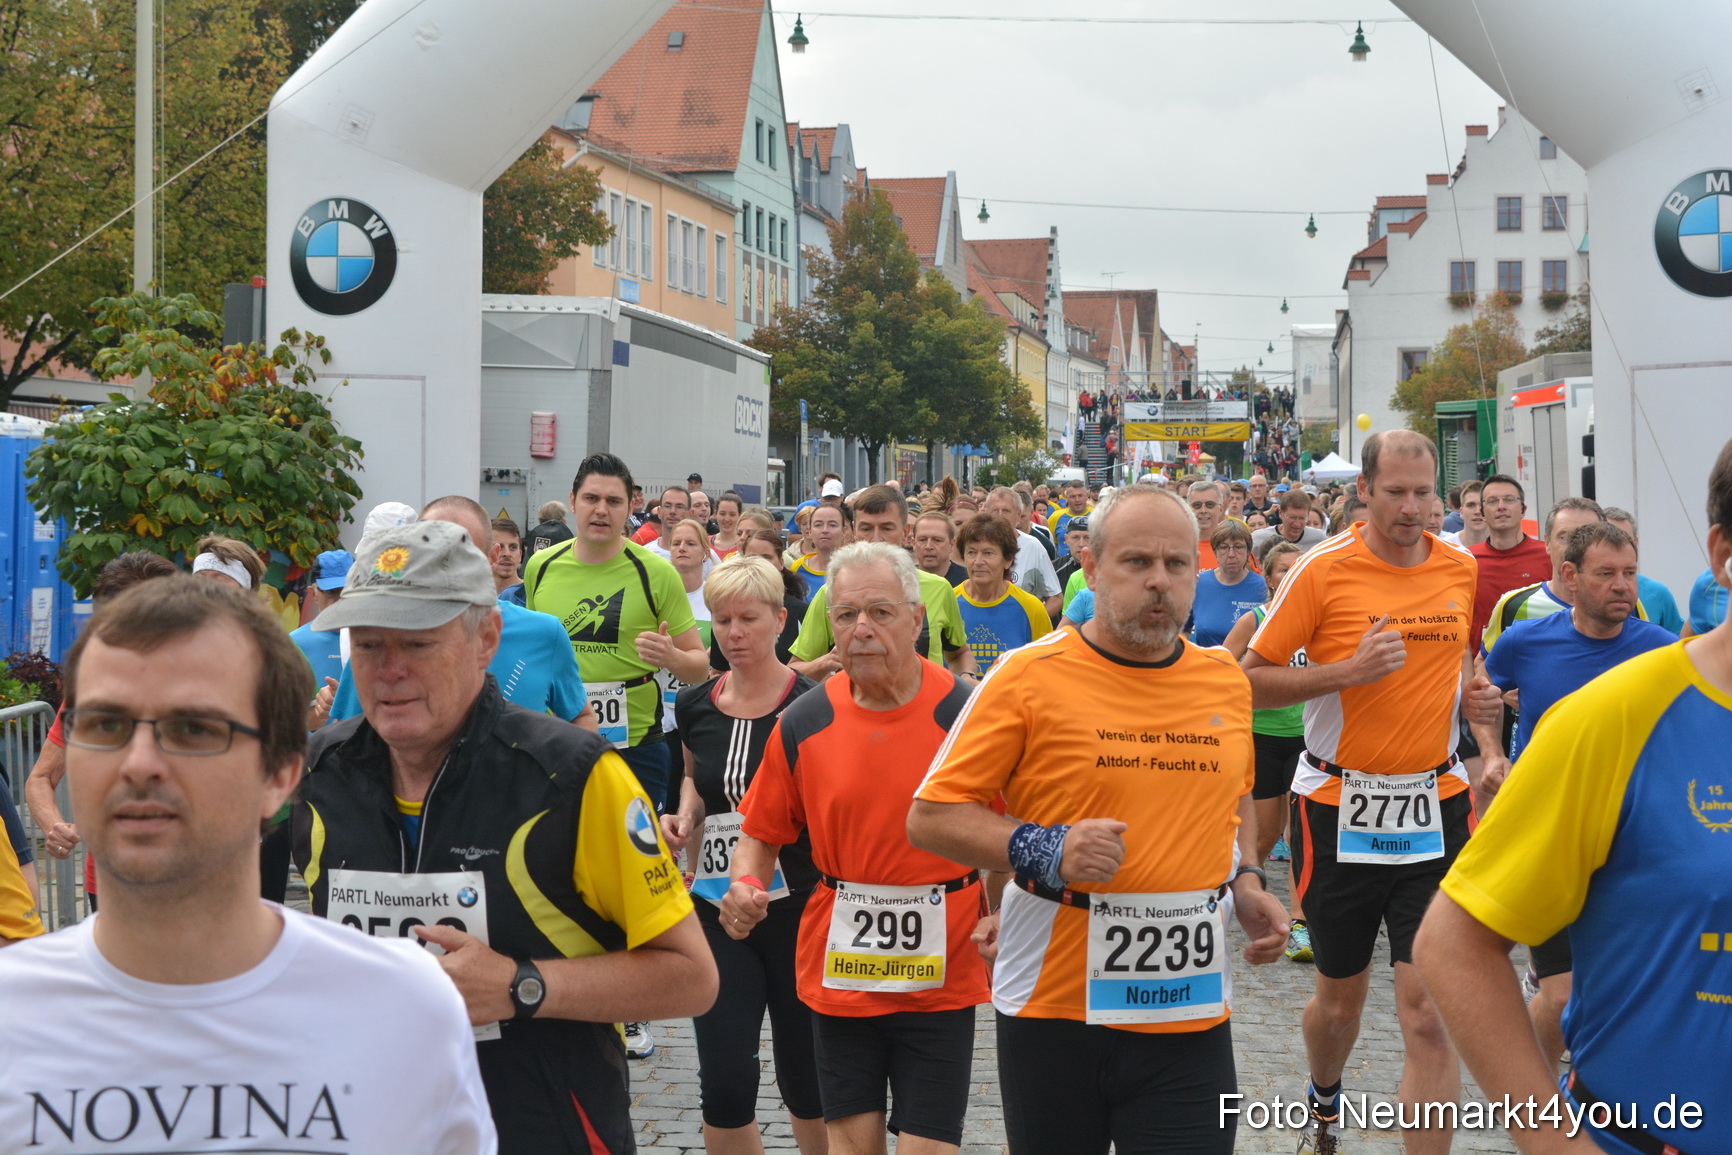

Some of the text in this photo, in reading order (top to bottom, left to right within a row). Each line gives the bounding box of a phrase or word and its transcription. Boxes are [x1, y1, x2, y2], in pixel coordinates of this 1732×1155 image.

[297, 200, 389, 240] BMW
[735, 394, 763, 438] BOCK
[1165, 426, 1208, 437] START
[1368, 614, 1458, 625] Vein der Notärzte
[1407, 632, 1440, 641] Feucht
[1443, 632, 1459, 642] e.V.
[572, 644, 618, 655] TRAWATT
[1096, 729, 1220, 746] Verein der Notärzte
[1096, 755, 1140, 768] Altdorf
[1150, 757, 1196, 771] Feucht
[1199, 760, 1221, 773] e.V.
[1344, 779, 1422, 790] PARTL Neumarkt
[1707, 785, 1723, 796] 15
[1350, 793, 1431, 828] 2770
[1700, 799, 1732, 811] Jahre
[1371, 837, 1411, 851] Armin
[331, 887, 371, 905] PARTL
[374, 890, 450, 907] Neumarkt
[837, 891, 925, 906] PARTL Neumarkt
[1093, 903, 1204, 918] PARTL Neumarkt
[851, 909, 922, 951] 299
[1104, 921, 1214, 972] 2239
[834, 957, 934, 979] Heinz-Jürgen
[1126, 983, 1191, 1005] Norbert
[25, 1083, 349, 1147] NOVINA
